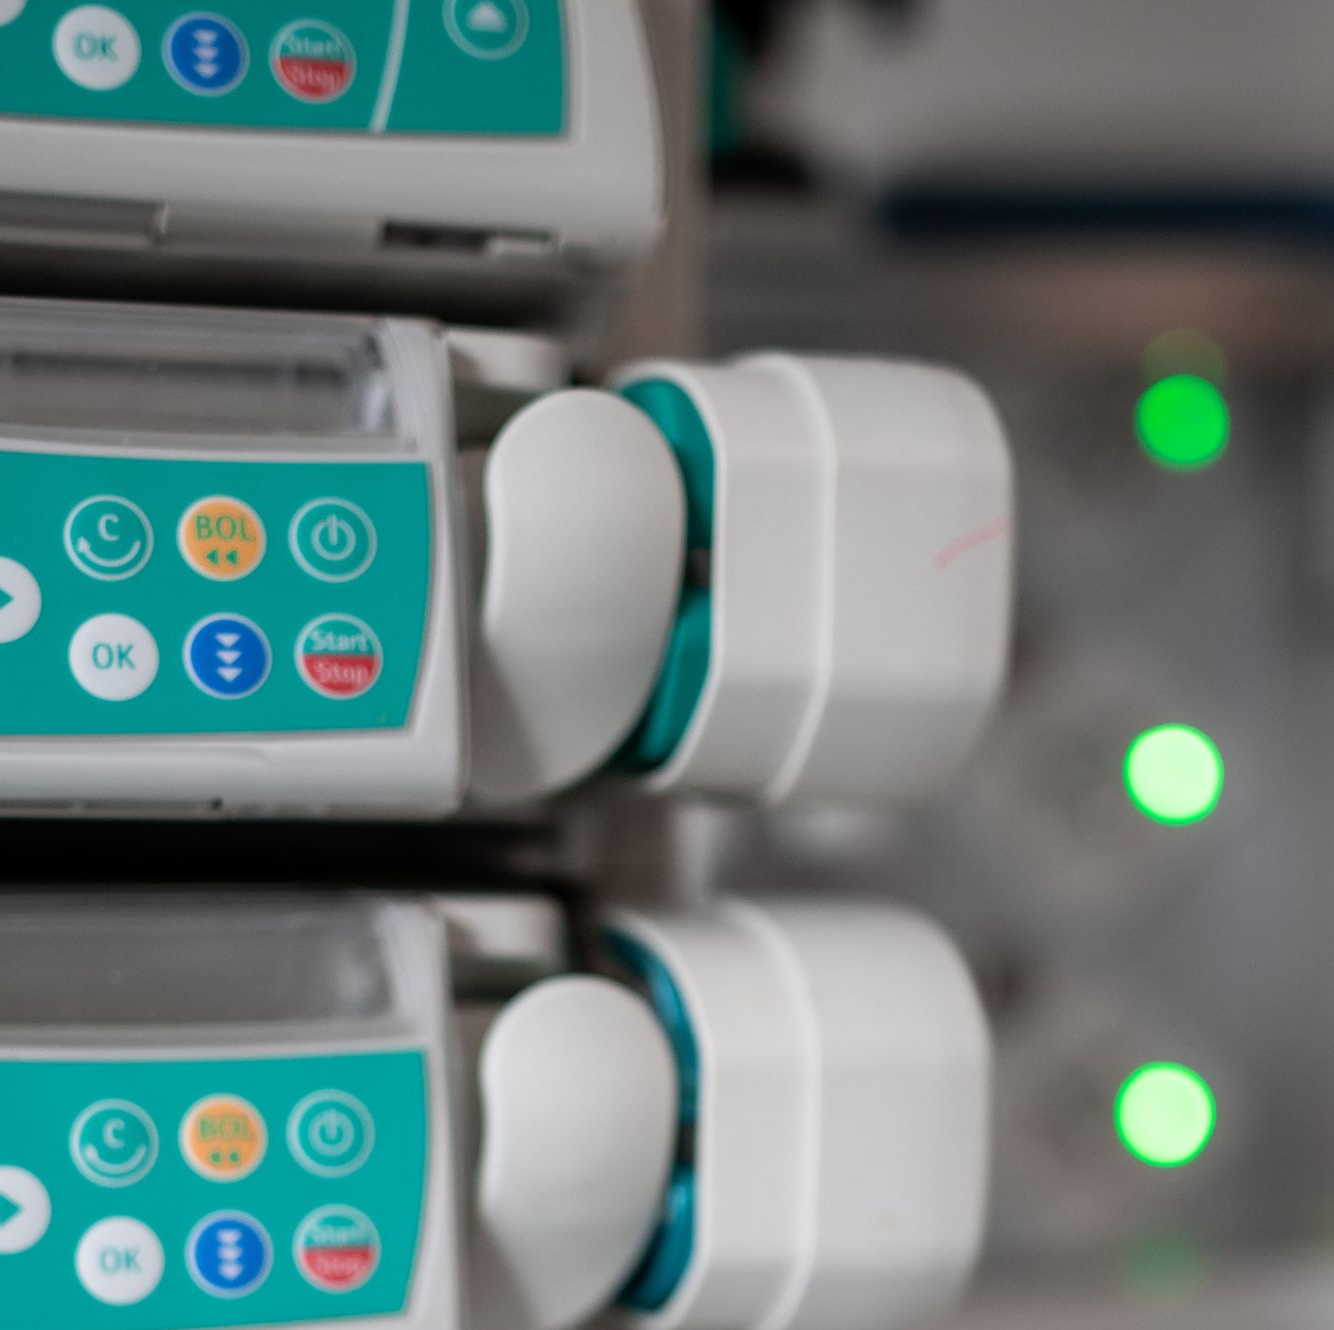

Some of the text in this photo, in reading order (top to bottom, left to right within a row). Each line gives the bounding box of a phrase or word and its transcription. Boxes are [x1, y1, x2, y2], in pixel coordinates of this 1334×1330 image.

[74, 31, 119, 62] OK
[97, 514, 120, 542] C
[194, 514, 254, 541] BOL
[310, 628, 367, 652] Start
[91, 642, 136, 671] OK
[315, 660, 368, 688] Stop
[98, 1248, 143, 1276] OK
